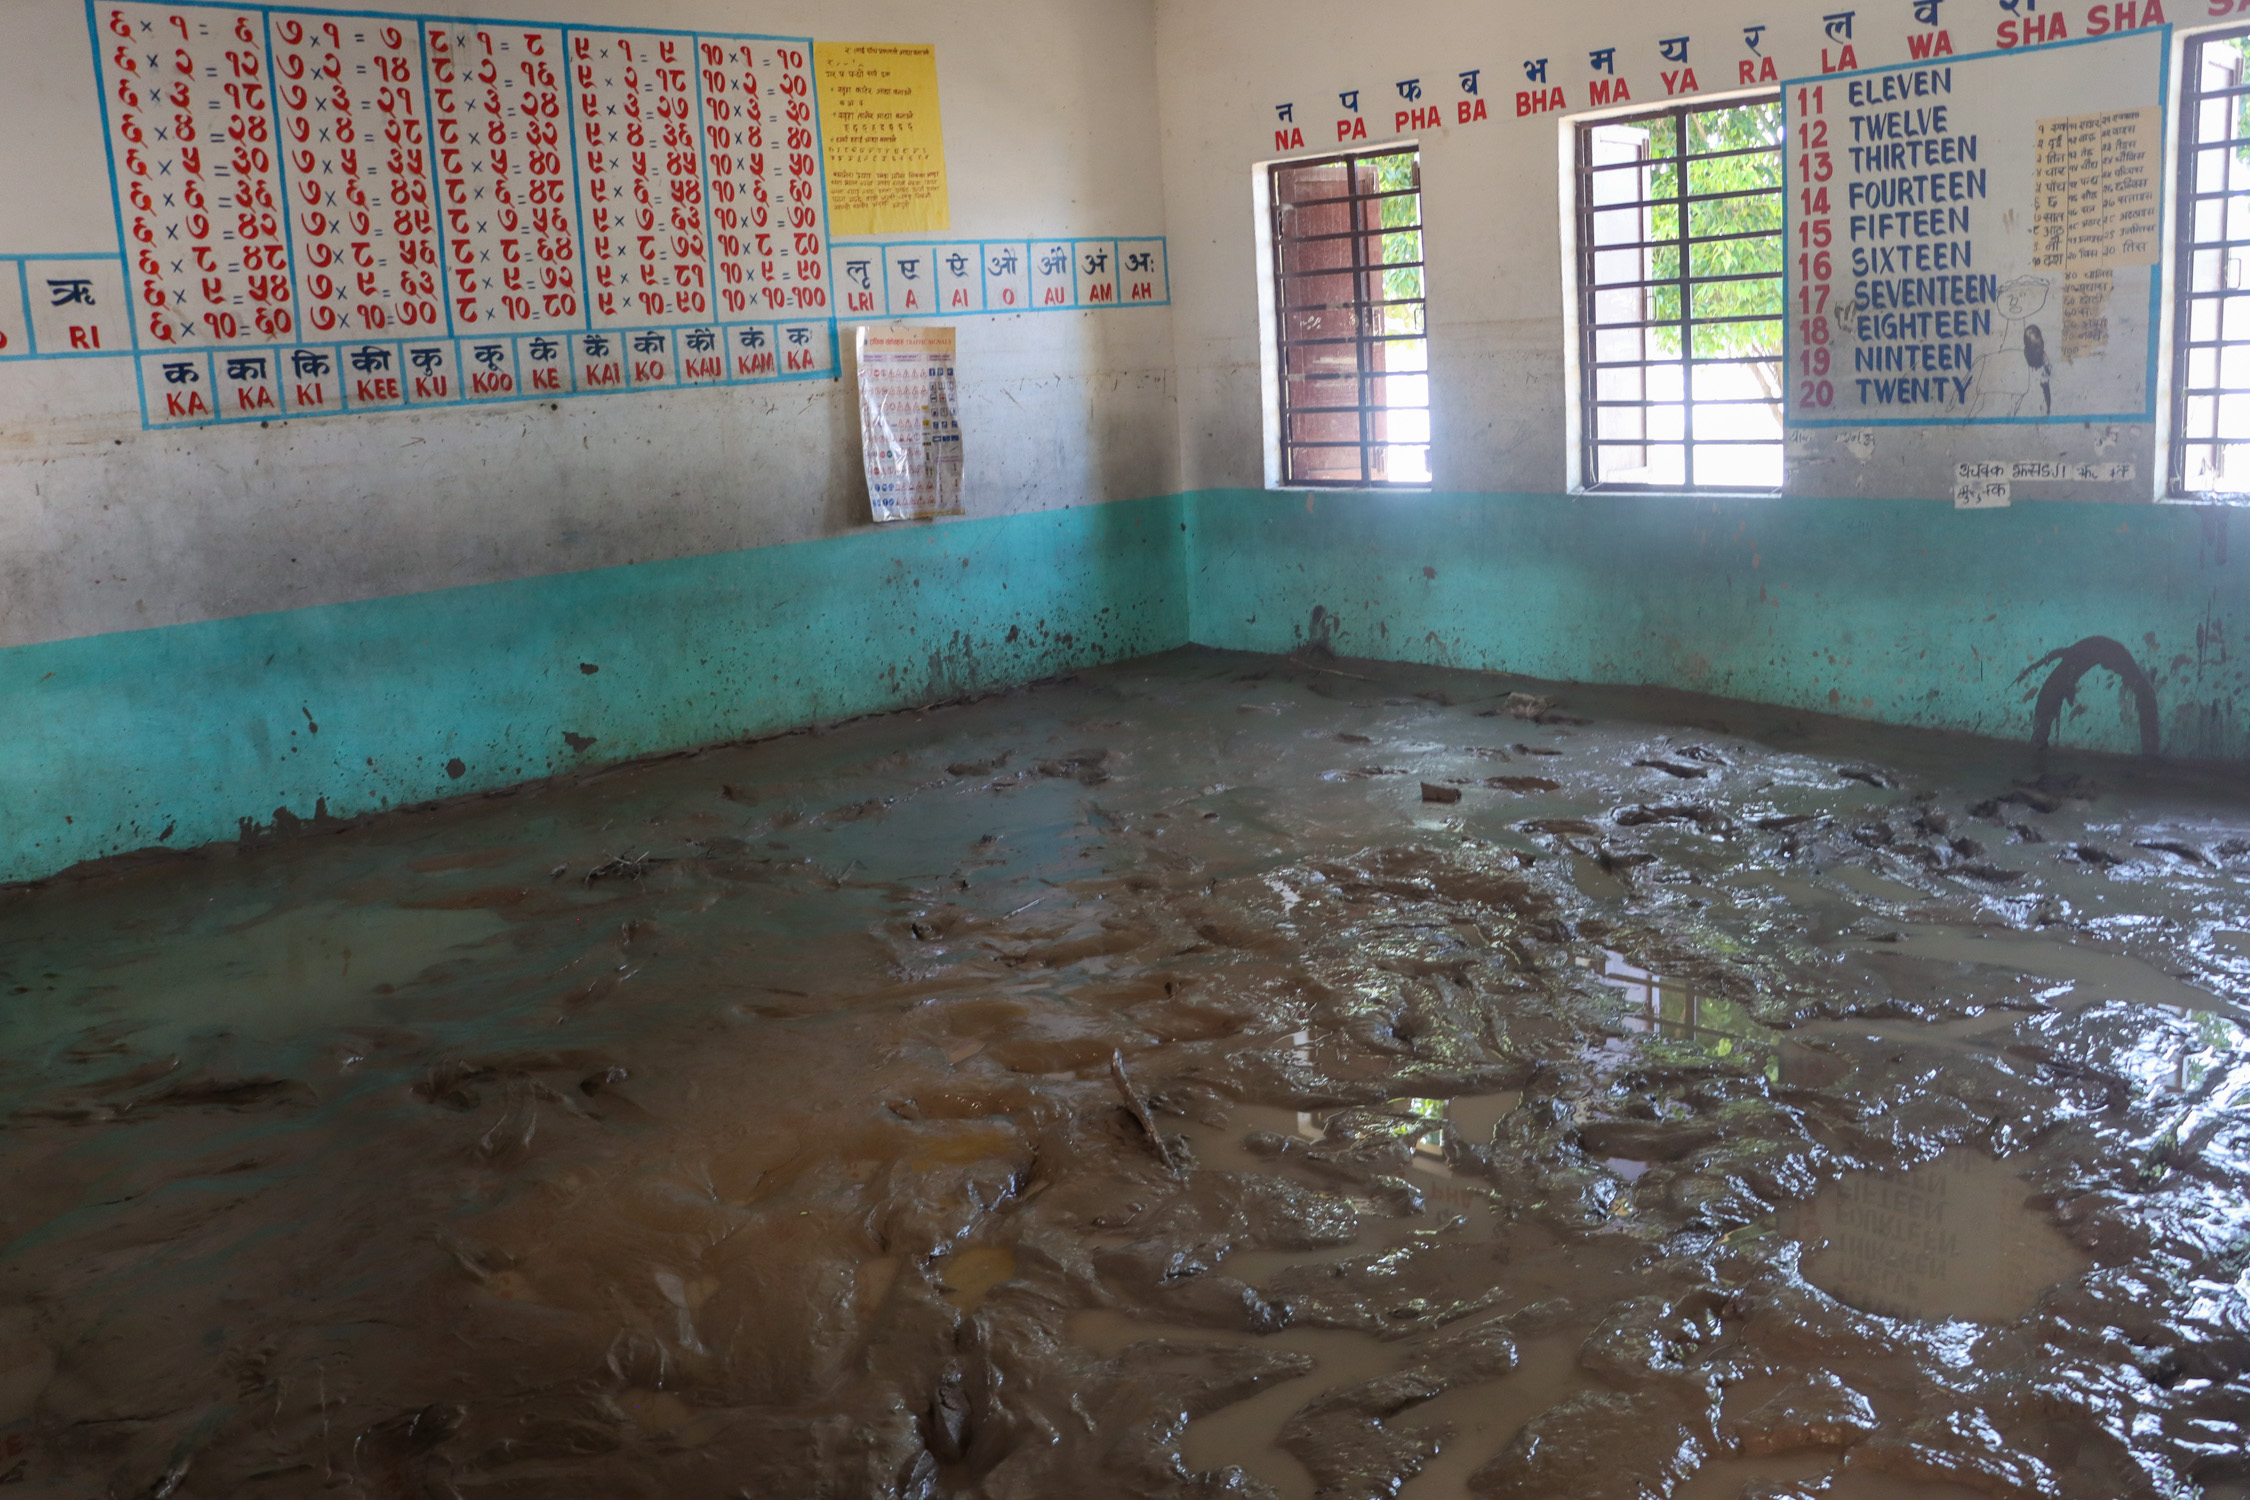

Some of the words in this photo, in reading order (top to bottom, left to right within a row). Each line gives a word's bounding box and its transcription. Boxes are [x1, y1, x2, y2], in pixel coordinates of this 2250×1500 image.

[109, 10, 136, 43] ६
[169, 15, 188, 40] १
[234, 17, 260, 49] ६
[277, 20, 303, 45] ७
[323, 22, 340, 48] १
[380, 27, 402, 50] ७
[477, 32, 492, 56] १
[618, 39, 632, 62] १
[701, 43, 723, 66] १०
[740, 46, 752, 68] १
[777, 49, 803, 70] १०
[1276, 103, 1293, 123] न
[1339, 90, 1359, 112] प
[1396, 79, 1421, 102] फ
[1459, 70, 1480, 95] ब
[1524, 59, 1548, 83] भ
[1589, 48, 1615, 74] म
[1659, 37, 1689, 63] य
[1744, 26, 1765, 56] र
[1823, 11, 1855, 40] ल
[1275, 128, 1305, 151] NA
[1337, 117, 1368, 142] PA
[1395, 105, 1442, 133] PHA
[1458, 98, 1488, 124] BA
[1516, 86, 1566, 117] BHA
[1589, 77, 1631, 107] MA
[1661, 68, 1699, 95] YA
[1739, 56, 1778, 85] RA
[1822, 45, 1857, 73] LA
[1908, 30, 1953, 59] WA
[1997, 12, 2067, 48] SHA
[2087, 0, 2164, 35] SHA
[1798, 87, 1823, 116] 11
[1847, 68, 1953, 108] ELEVEN
[1799, 122, 1828, 149] 12
[1849, 105, 1948, 143] TWELVE
[126, 148, 152, 180] ६
[181, 146, 204, 181] ५
[232, 146, 269, 180] ३०
[292, 150, 315, 174] ७
[341, 148, 360, 182] ५
[387, 148, 426, 182] ३५
[490, 149, 508, 183] ५
[529, 146, 560, 175] ४०
[632, 151, 649, 184] ५
[666, 152, 699, 178] ४५
[1799, 152, 1833, 182] 13
[1848, 134, 1978, 174] THIRTEEN
[1799, 187, 1831, 215] 14
[1848, 169, 1987, 210] FOURTEEN
[1799, 219, 1833, 248] 15
[1849, 206, 1970, 243] FIFTEEN
[898, 260, 919, 279] ए
[946, 253, 968, 276] ऐ
[987, 248, 1017, 277] ओ
[1037, 247, 1068, 277] औ
[1081, 250, 1107, 276] अं
[1800, 252, 1832, 281] 16
[1852, 241, 1972, 277] SIXTEEN
[47, 279, 95, 306] ऋ
[848, 292, 874, 311] LRI
[906, 290, 916, 308] A
[952, 289, 968, 306] AI
[1003, 289, 1014, 304] O
[1045, 288, 1064, 304] AU
[1090, 283, 1112, 301] AM
[1132, 283, 1151, 299] AH
[1799, 285, 1831, 314] 17
[1854, 274, 1997, 311] SEVENTEEN
[69, 325, 100, 349] RI
[1800, 317, 1830, 346] 18
[1857, 309, 1991, 342] EIGHTEEN
[162, 362, 199, 384] क
[227, 358, 266, 381] का
[291, 349, 330, 379] कि
[349, 343, 391, 375] की
[410, 348, 442, 377] कु
[474, 345, 504, 371] कू
[527, 335, 559, 362] के
[583, 334, 609, 358] कै
[631, 328, 665, 354] को
[684, 324, 719, 353] कौ
[739, 327, 764, 349] कं
[1800, 349, 1830, 376] 19
[1855, 343, 1972, 372] NINTEEN
[166, 391, 207, 416] KA
[238, 386, 273, 410] KA
[296, 383, 323, 405] KI
[357, 378, 399, 400] KEE
[416, 376, 447, 397] KU
[473, 372, 512, 393] KOO
[533, 368, 560, 388] KE
[586, 362, 620, 385] KAI
[636, 360, 664, 382] KO
[686, 357, 721, 378] KAU
[739, 352, 773, 374] KAM
[788, 349, 813, 370] KA
[1799, 380, 1834, 408] 20
[1856, 376, 1972, 405] TWENTY
